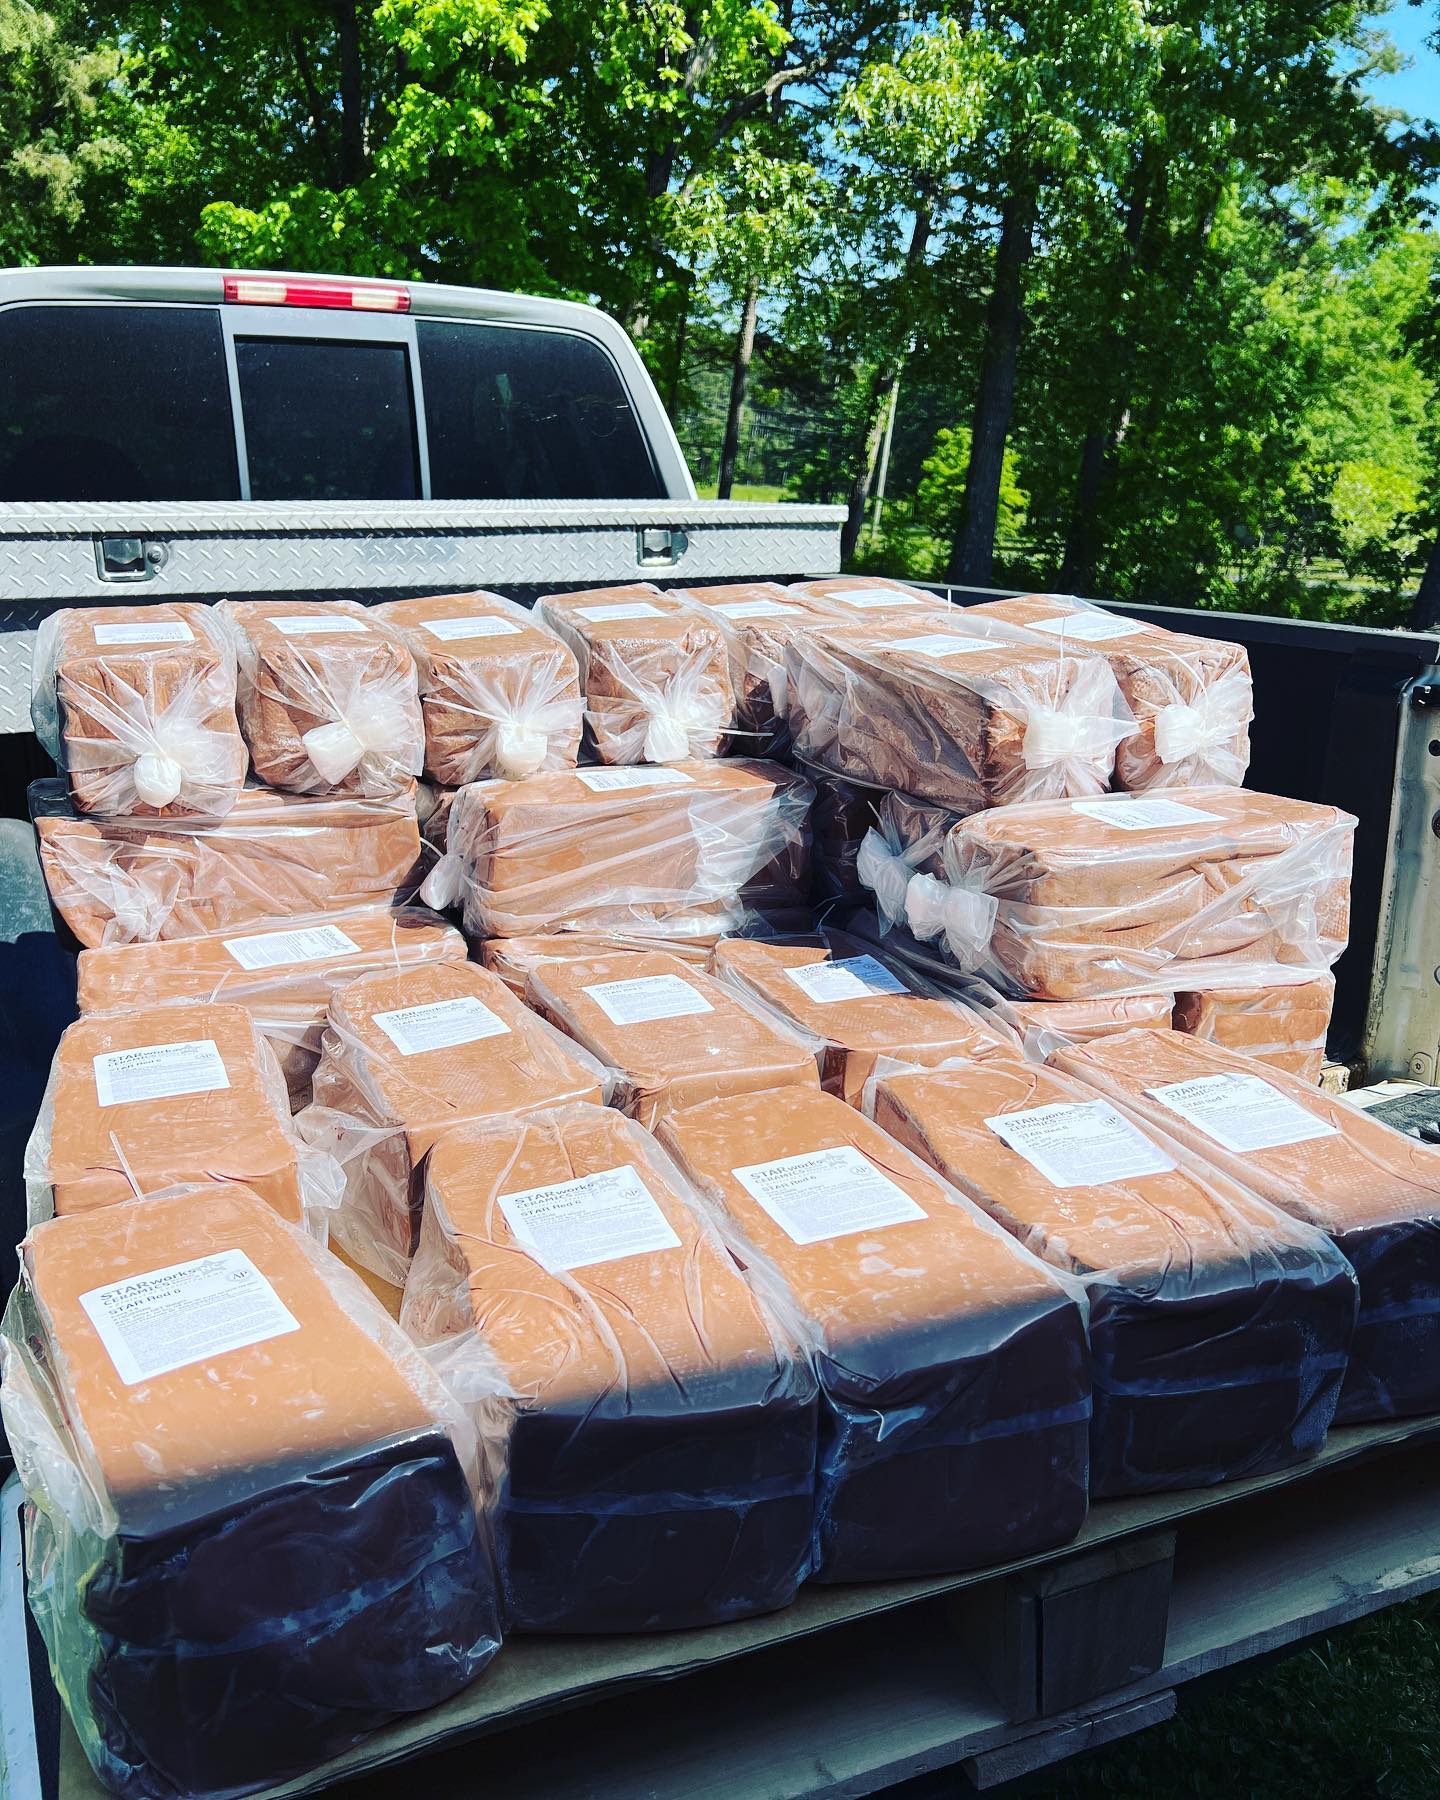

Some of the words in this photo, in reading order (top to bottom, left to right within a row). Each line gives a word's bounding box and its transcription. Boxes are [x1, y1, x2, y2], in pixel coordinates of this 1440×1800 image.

[1004, 1110, 1074, 1128] STARworks
[750, 1159, 824, 1180] STARworks
[514, 1183, 595, 1204] STARworks
[516, 1192, 572, 1209] CERAMICS
[520, 1205, 551, 1217] STAR
[100, 1268, 197, 1301] STARworks
[103, 1280, 171, 1306] CERAMICS
[108, 1301, 145, 1315] STAR
[147, 1290, 172, 1303] Red
